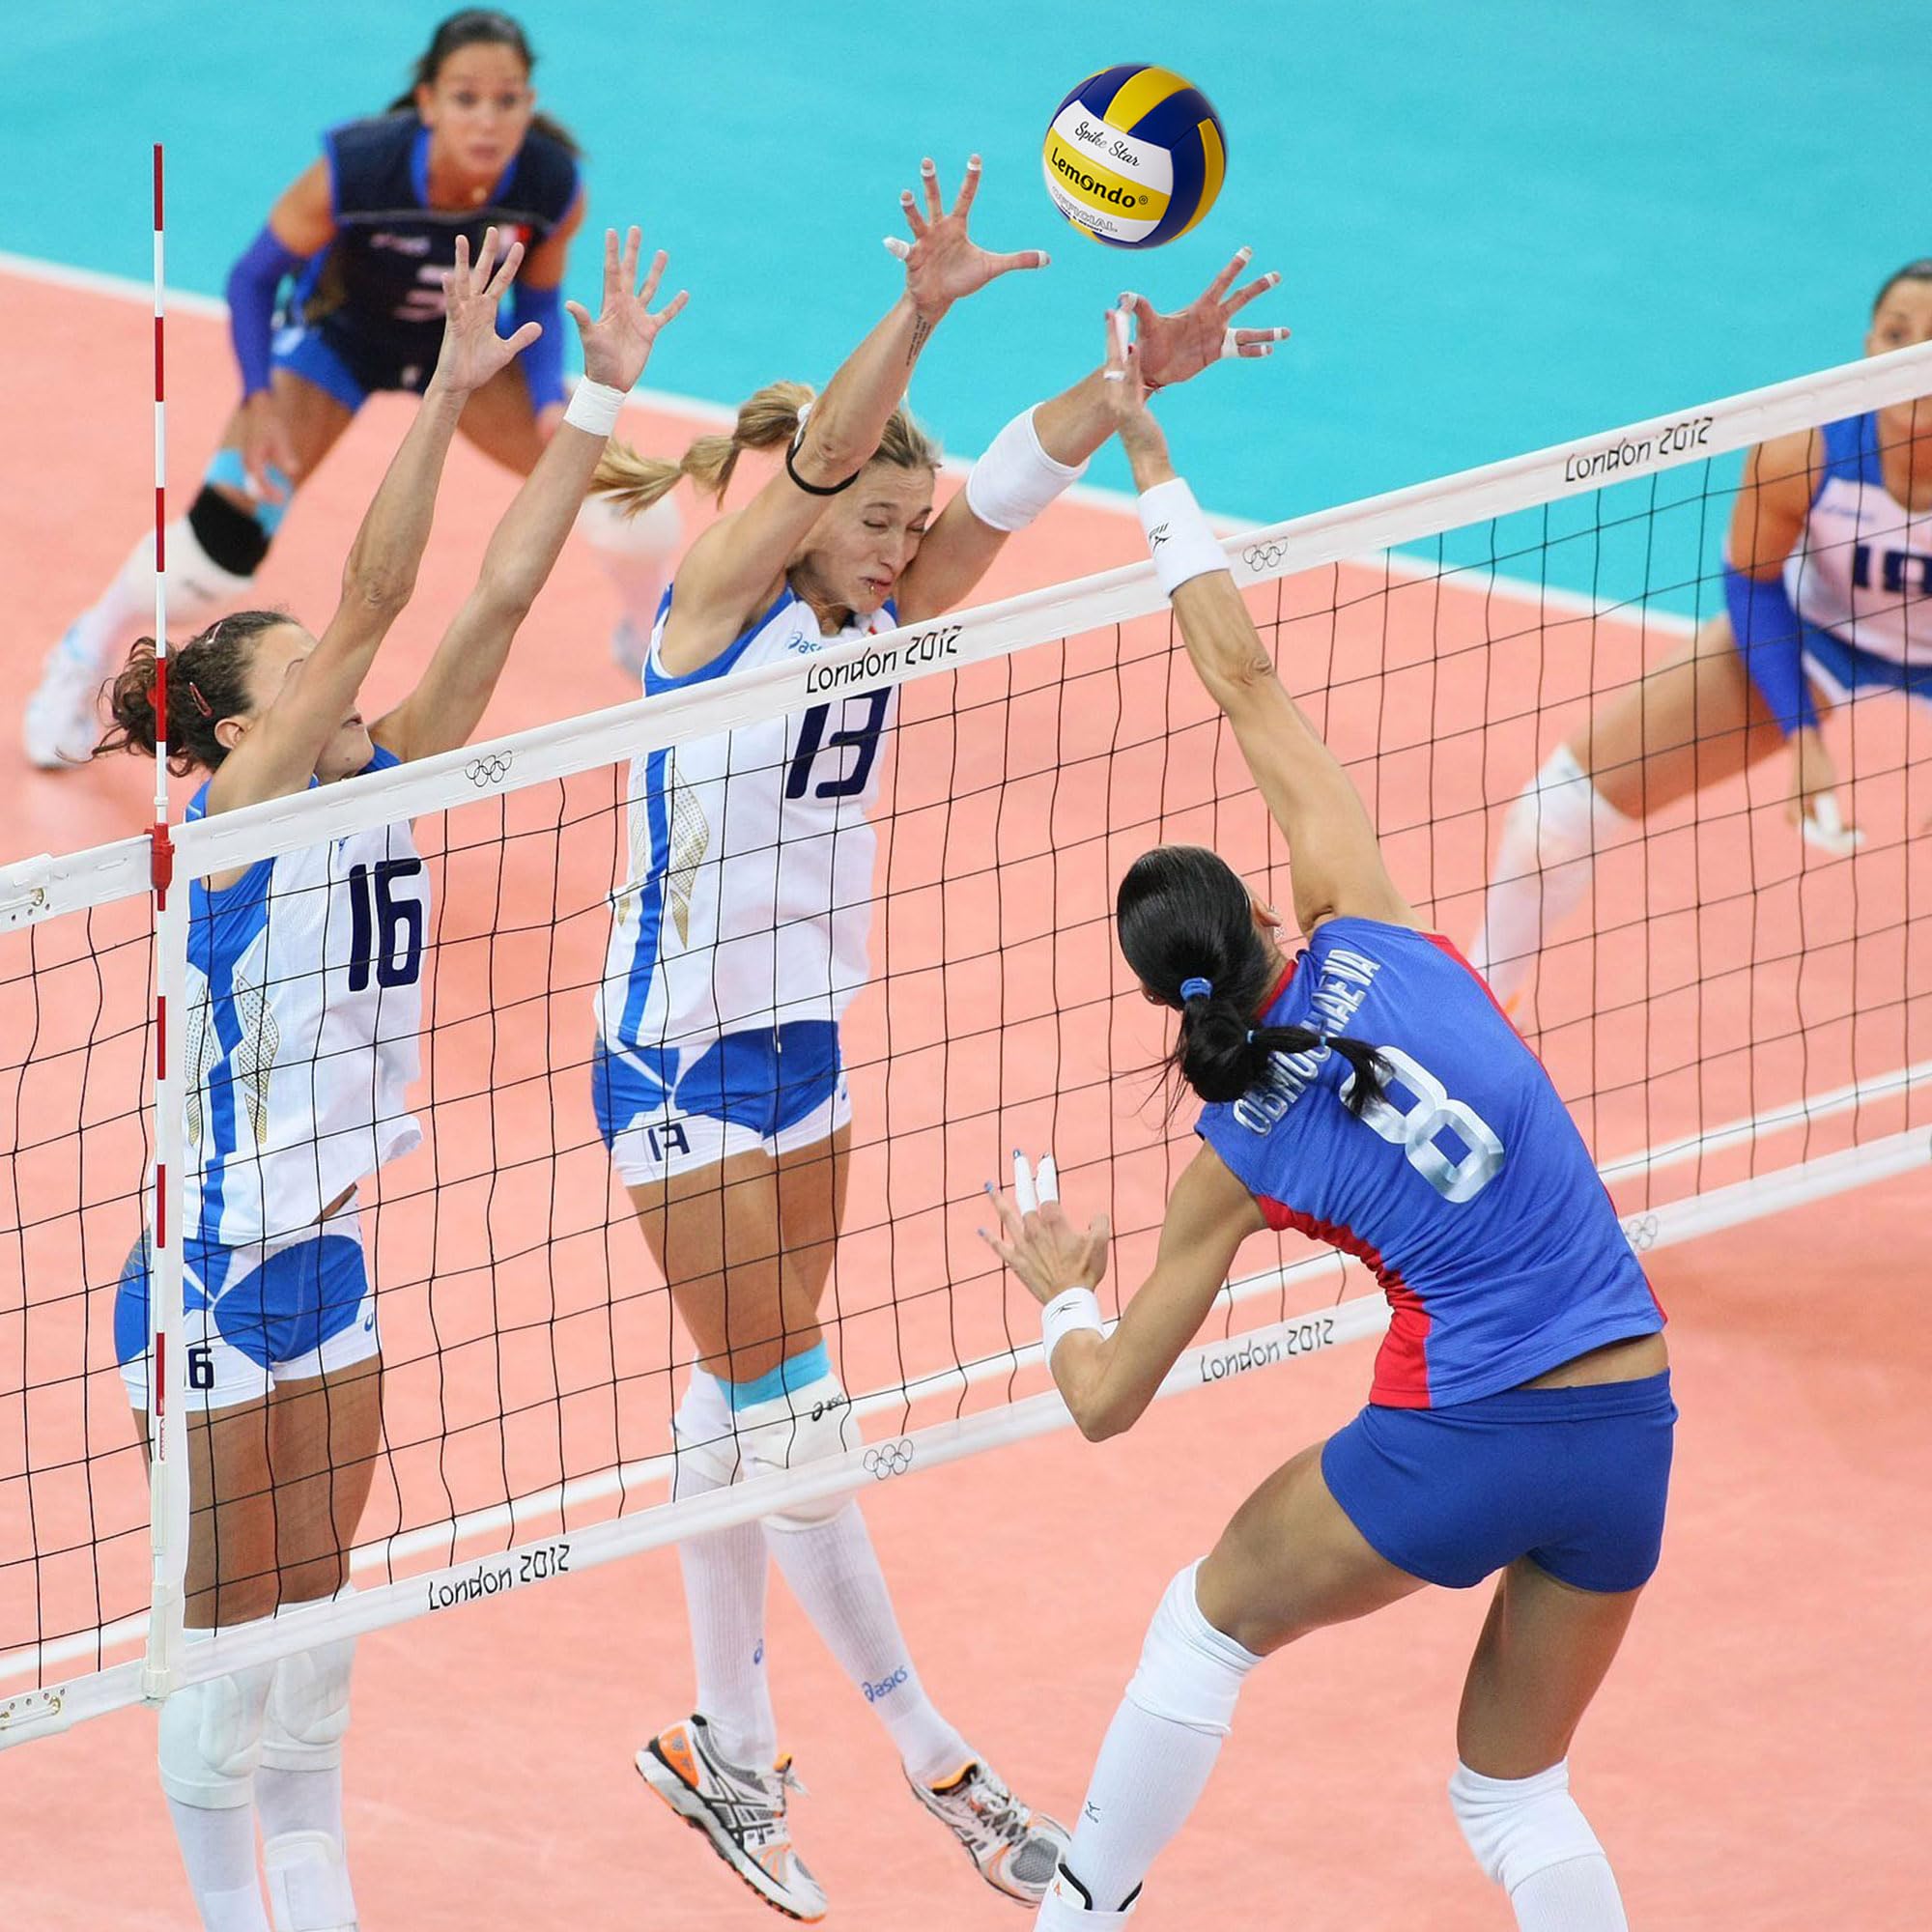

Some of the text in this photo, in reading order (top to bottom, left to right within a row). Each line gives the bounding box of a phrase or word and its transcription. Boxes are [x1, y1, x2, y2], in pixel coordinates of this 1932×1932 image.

[1074, 121, 1140, 167] Spike Star
[1565, 416, 1714, 482] London 2012
[806, 625, 963, 694] London 2012
[785, 685, 893, 800] 13
[349, 857, 422, 992] 16
[1339, 1045, 1506, 1204] 8
[1200, 1318, 1335, 1382] London 2012
[428, 1544, 570, 1610] London 2012
